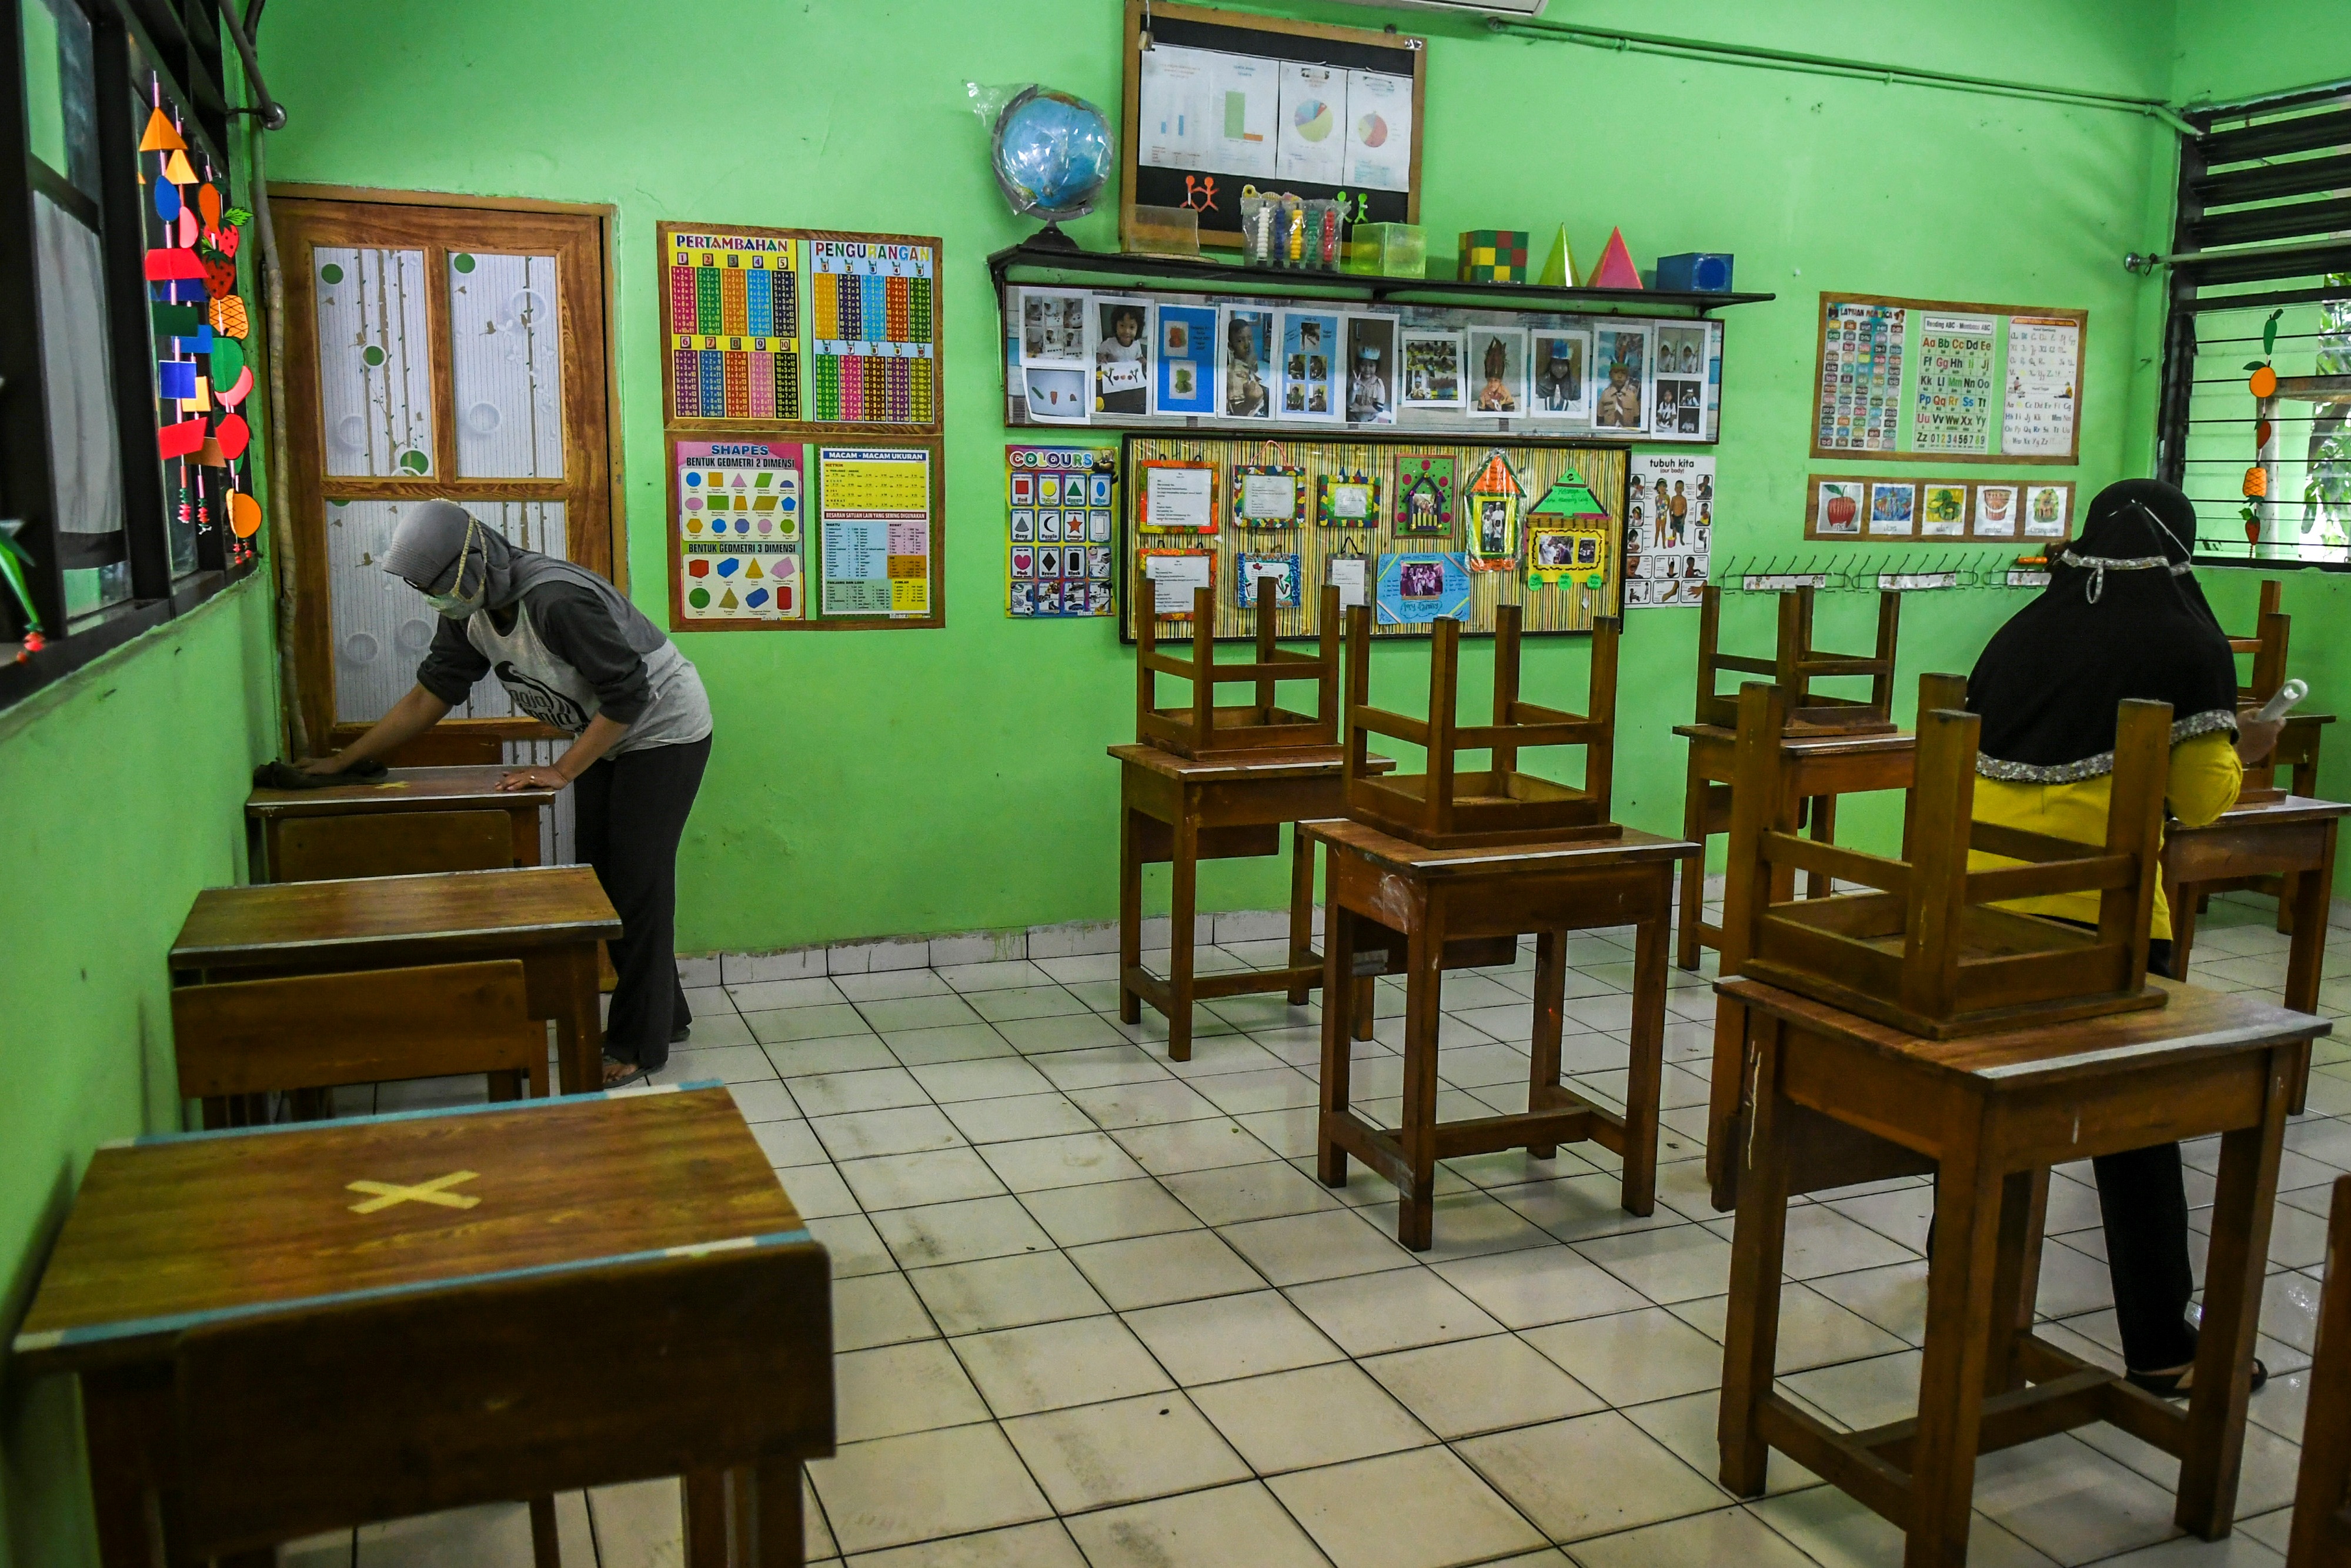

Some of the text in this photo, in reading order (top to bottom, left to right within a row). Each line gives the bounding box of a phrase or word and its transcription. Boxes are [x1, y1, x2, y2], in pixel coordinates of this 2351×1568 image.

[677, 235, 787, 252] PERTAMBAHAN
[816, 242, 929, 261] PENGURANGAN
[1927, 320, 1944, 329] Reading
[1923, 337, 1991, 350] Aa Bb Cc Dd Ee
[1924, 356, 1932, 366] Ff
[1936, 357, 1948, 369] Gg
[1951, 358, 1962, 368] Hh
[1981, 359, 1989, 371] Jj
[1921, 376, 1989, 388] Kk Ll Mm Nn Oo
[1919, 394, 1986, 407] Pp Qq Rr Ss Tt
[1918, 413, 1986, 427] Uu Vv Ww Xx Yy
[1917, 432, 1928, 442] Zz
[1942, 434, 1945, 443] 2
[1948, 434, 1952, 443] 3
[1953, 434, 1957, 443] 4
[1959, 434, 1963, 443] 5
[1963, 435, 1968, 444] 6
[1969, 435, 1973, 444] 7
[1981, 436, 1985, 444] 9
[712, 445, 769, 455] SHAPES
[687, 457, 794, 467] BENTUK GEOMETRI 2 DIMENSI
[1010, 451, 1093, 468] COLOURS
[1650, 459, 1694, 467] tubuh kita
[689, 544, 717, 552] BENTUK
[720, 544, 755, 553] GEOMETRI
[765, 544, 795, 553] DIMENSI
[1404, 602, 1439, 611] My family
